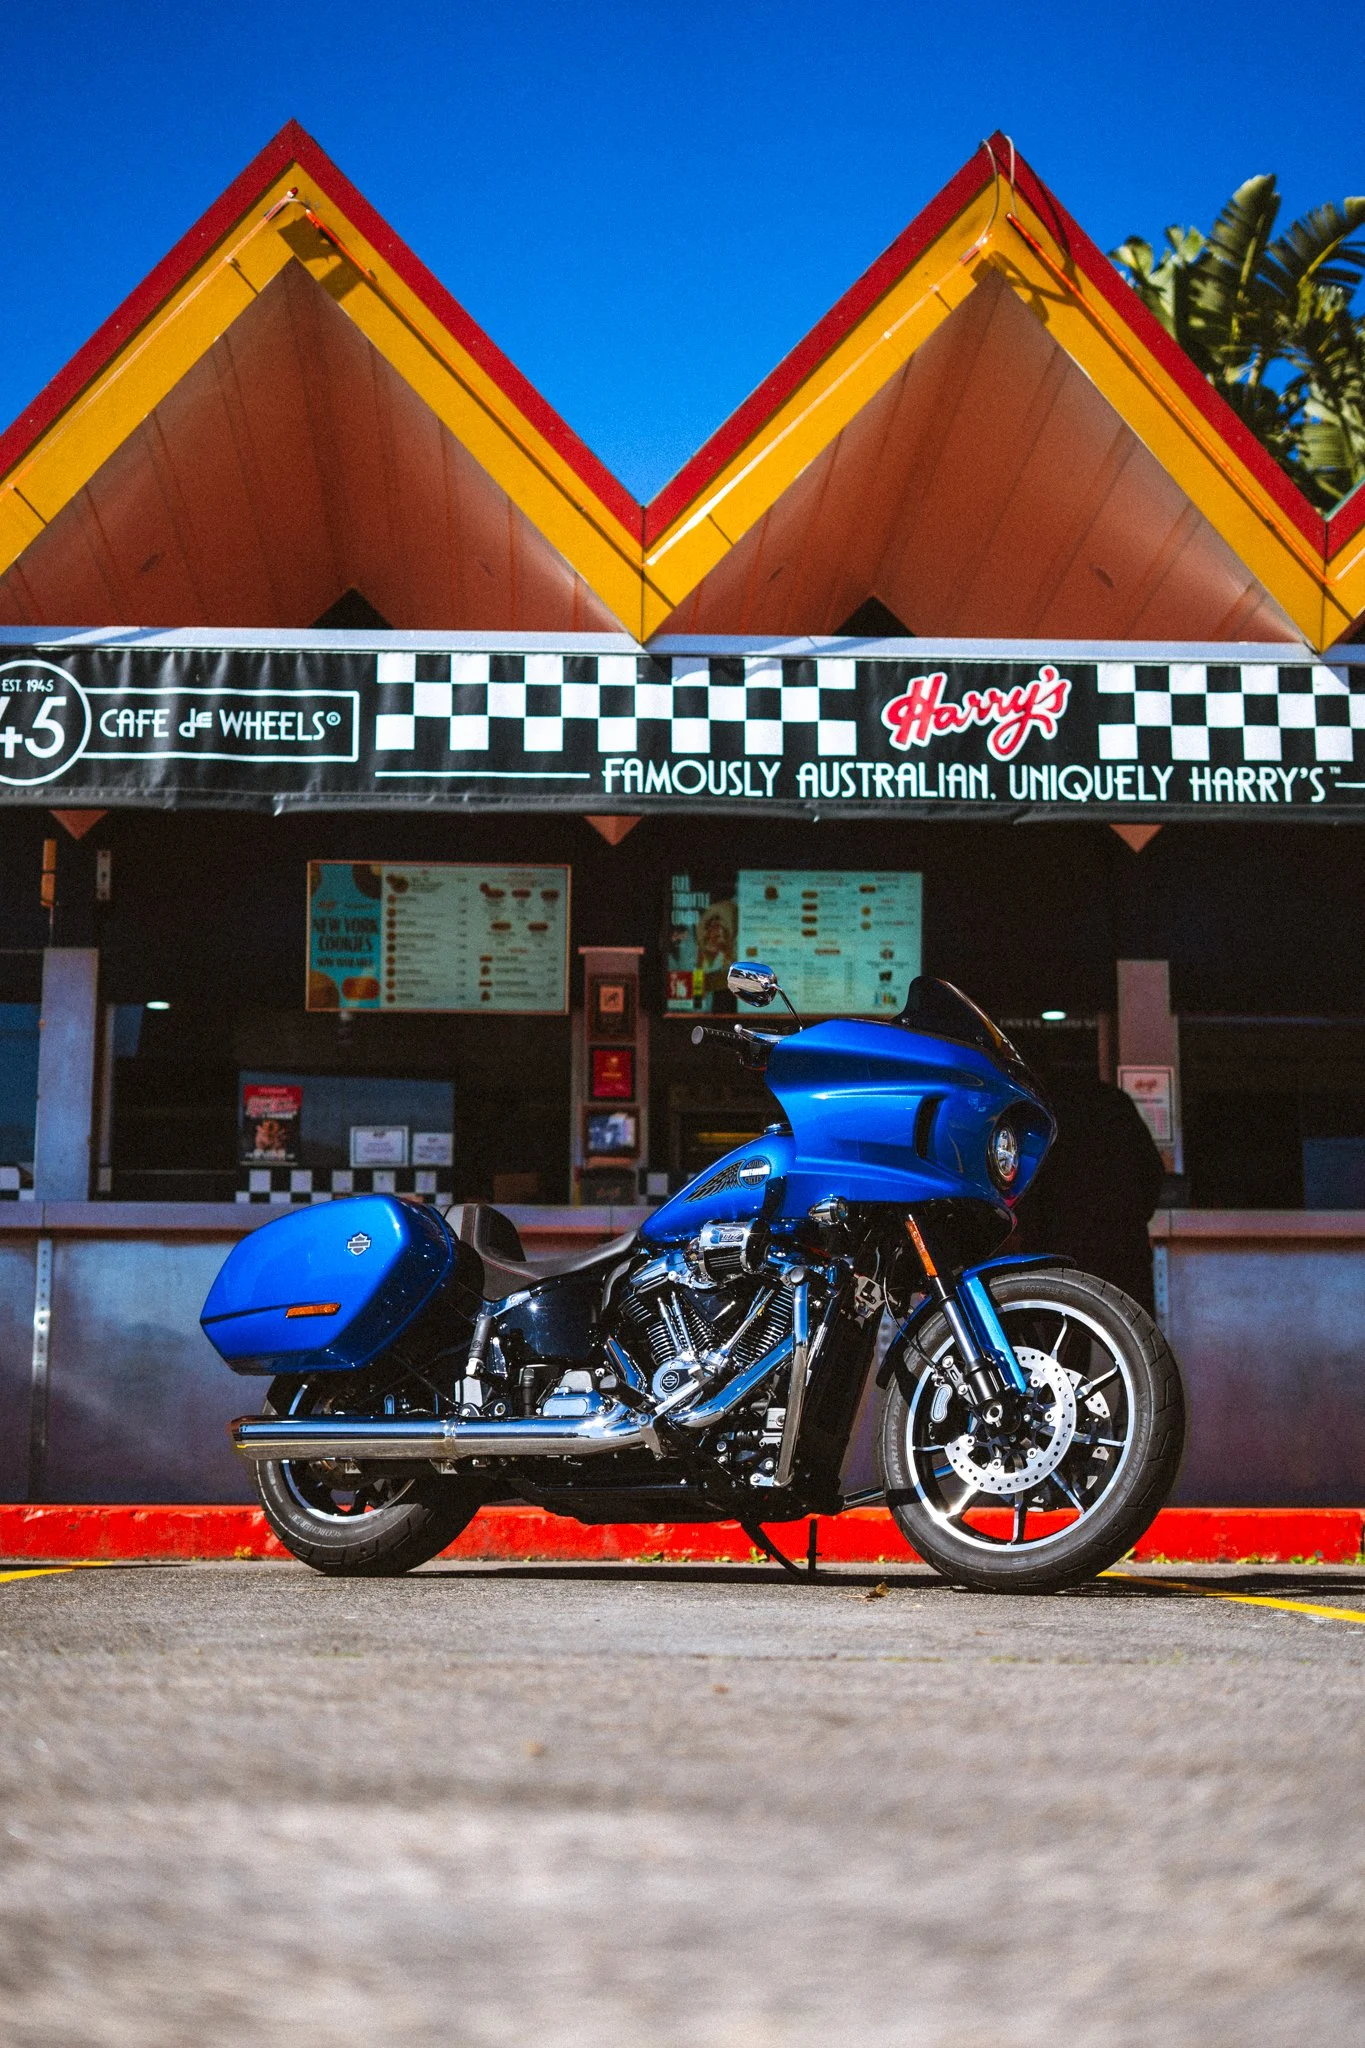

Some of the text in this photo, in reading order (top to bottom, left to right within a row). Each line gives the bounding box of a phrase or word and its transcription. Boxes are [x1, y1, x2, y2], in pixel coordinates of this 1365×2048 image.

[2, 678, 54, 692] EST. 1945
[99, 708, 171, 739] CAFE
[881, 665, 1071, 761] Harry's
[601, 757, 781, 797] FAMOUSLY
[1009, 764, 1174, 803] UNIQUELY
